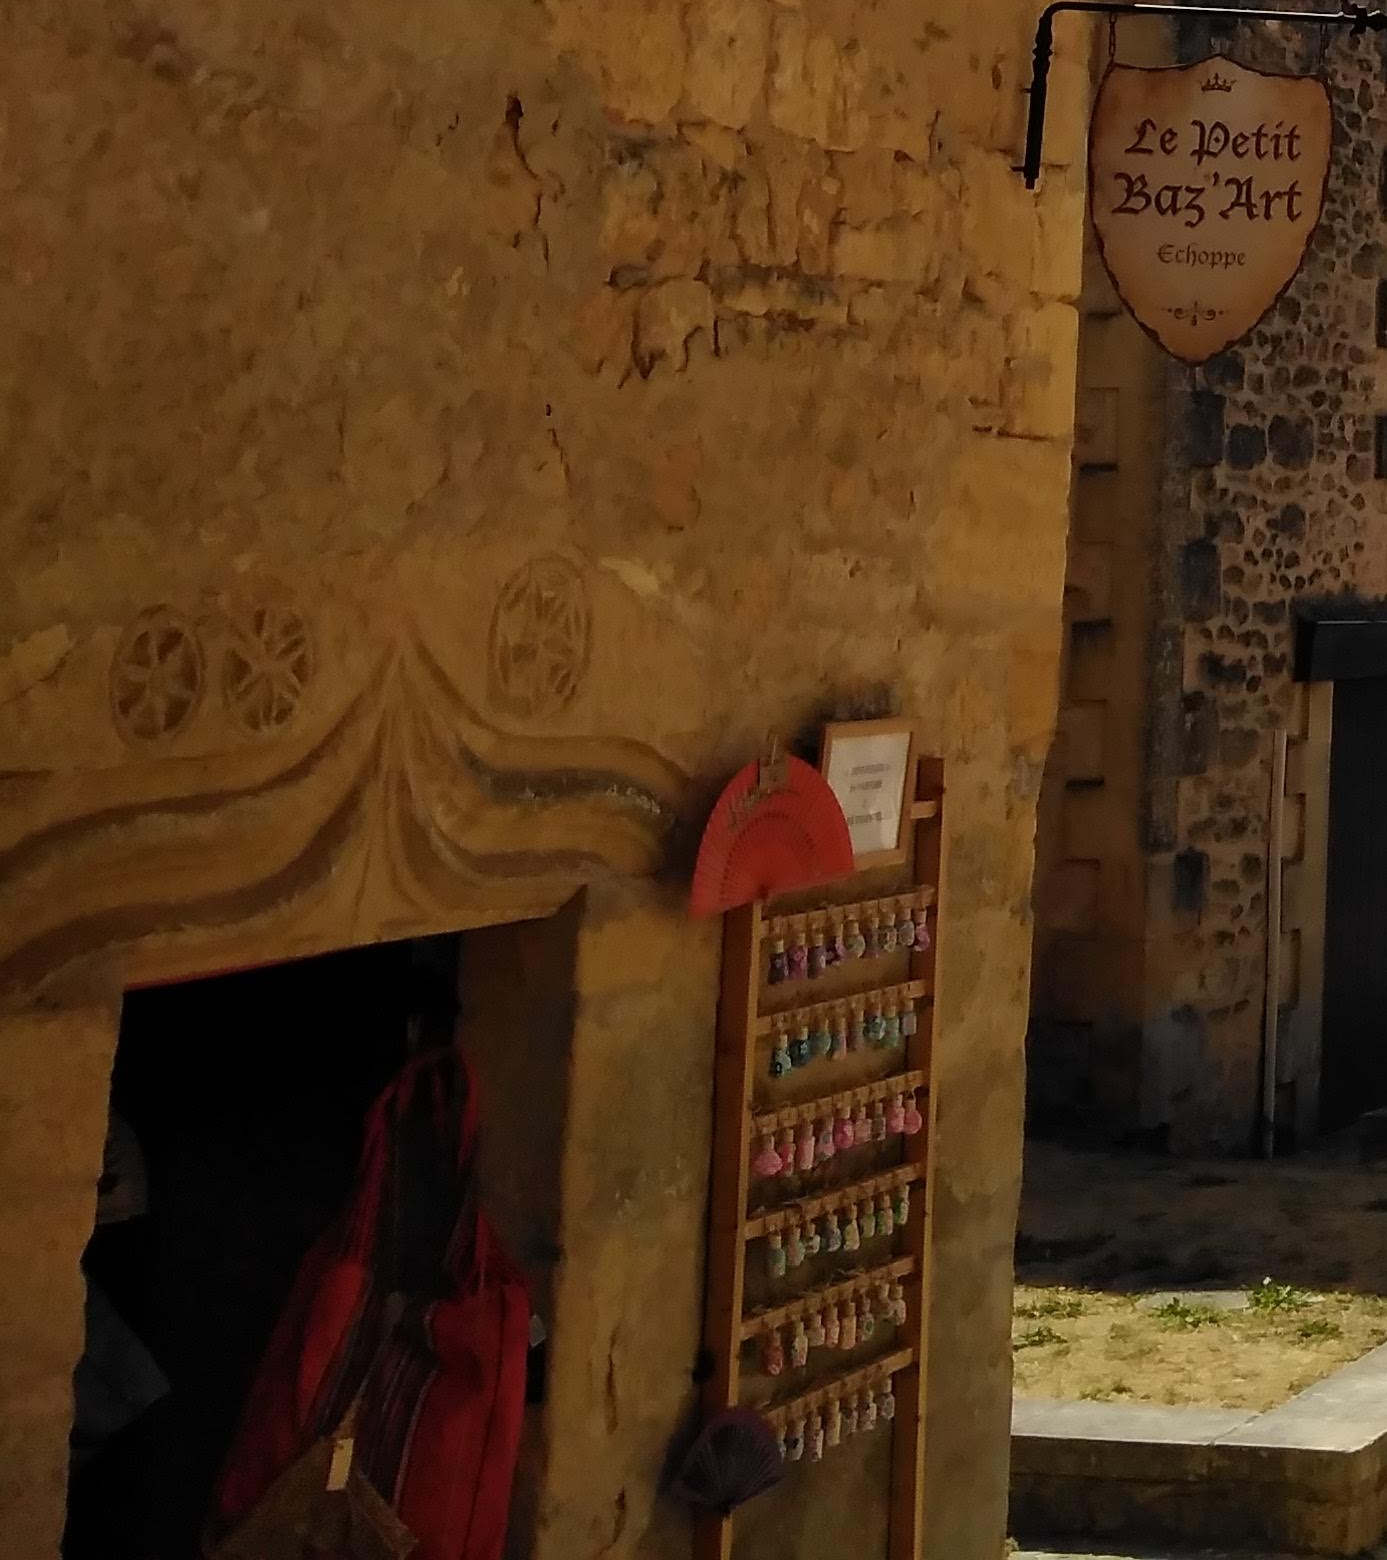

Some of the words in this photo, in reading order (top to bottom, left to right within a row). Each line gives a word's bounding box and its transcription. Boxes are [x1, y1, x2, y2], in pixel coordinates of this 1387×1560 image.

[1125, 118, 1178, 155] Le
[1190, 120, 1302, 166] Petit
[1111, 171, 1303, 228] Baz'Art
[1156, 243, 1247, 270] Echoppe
